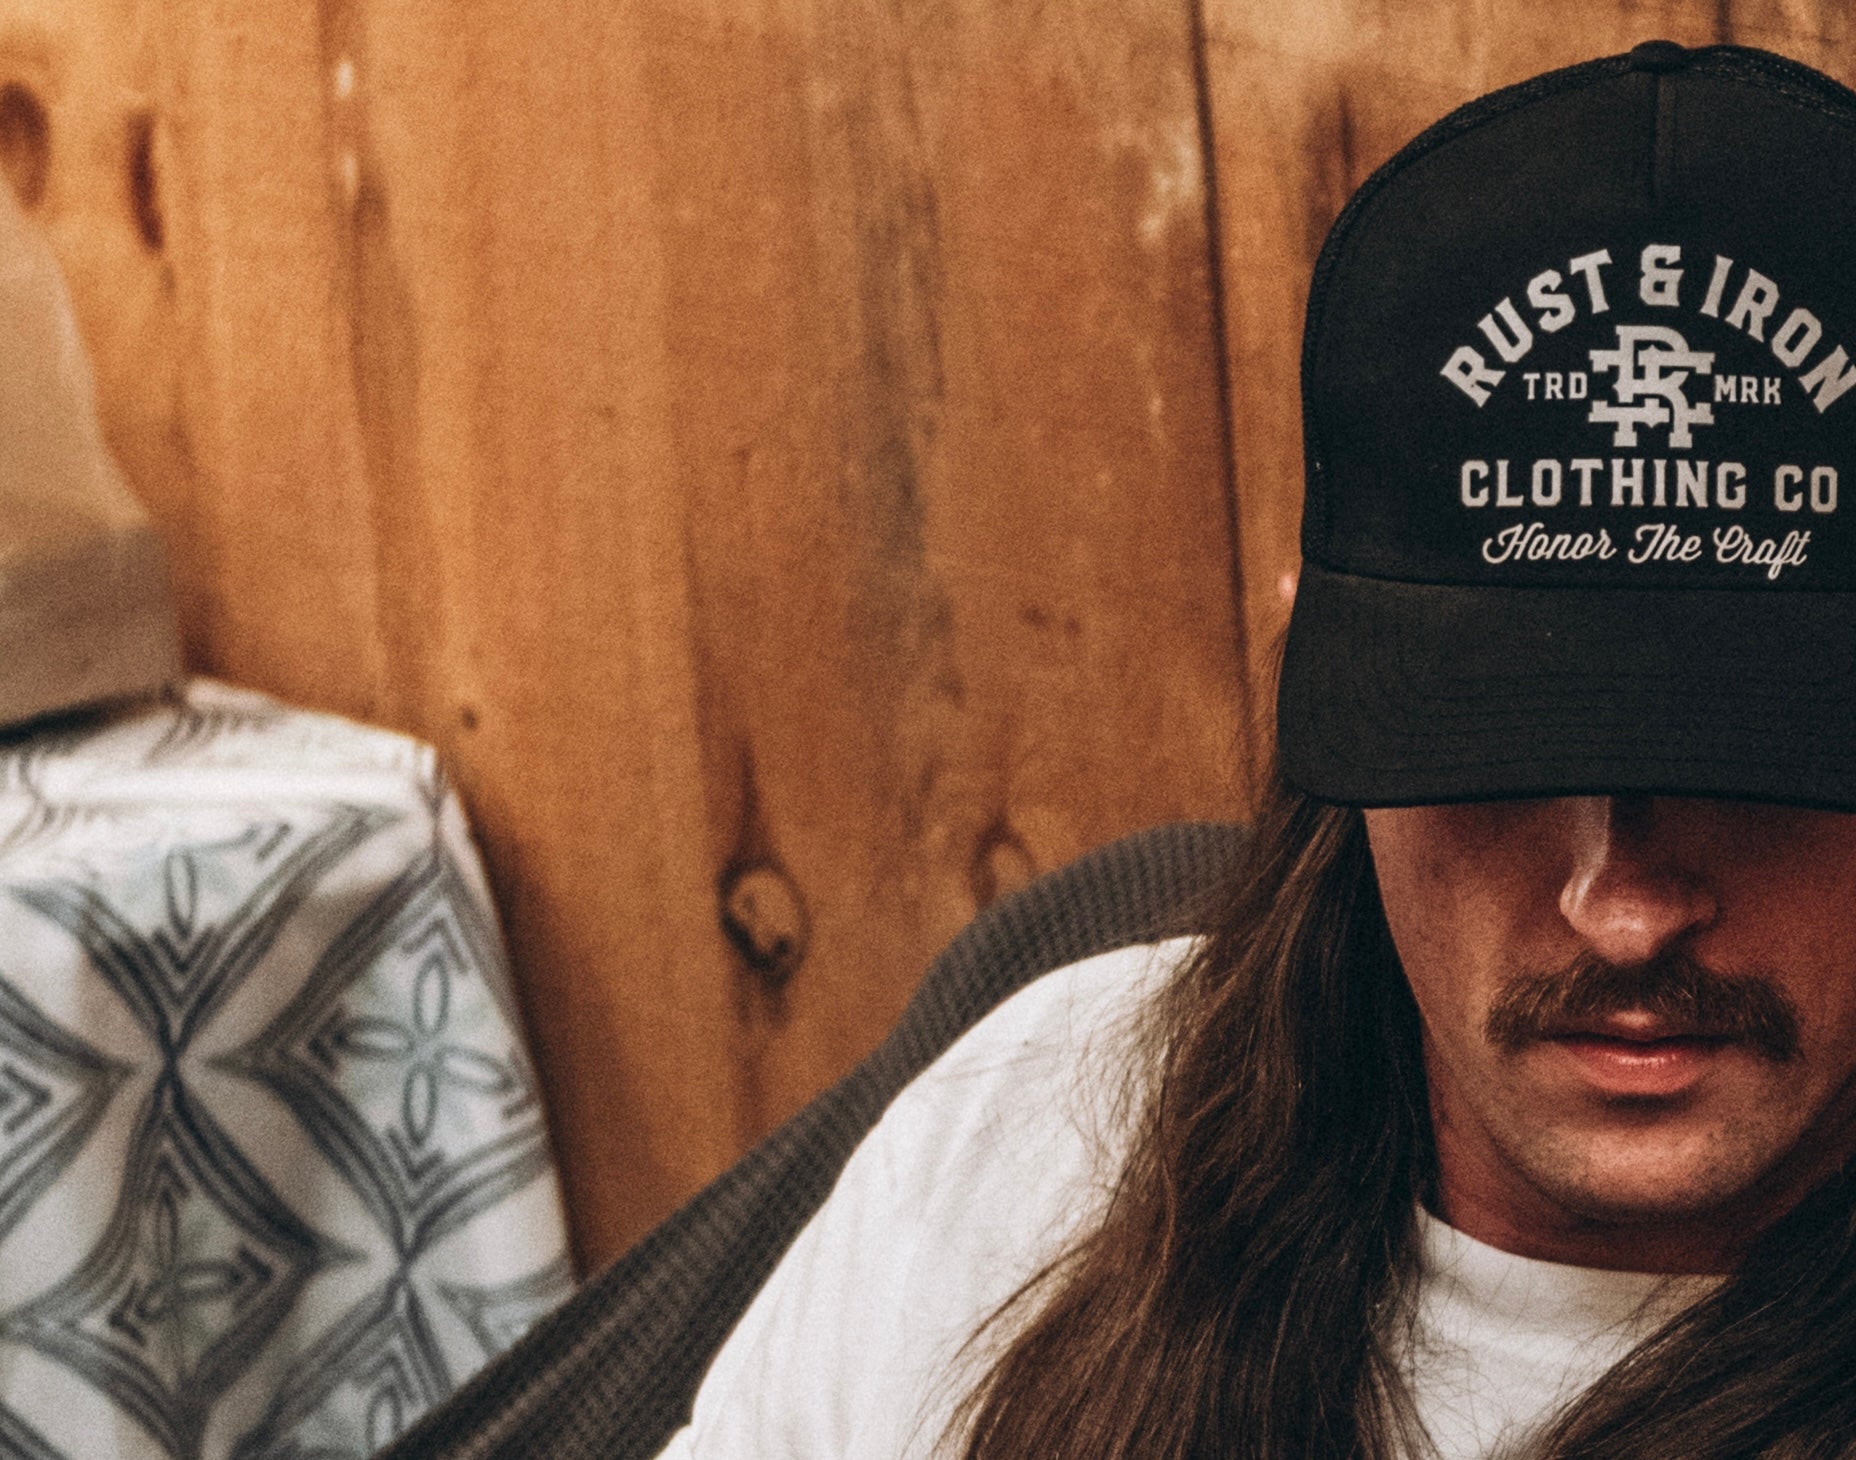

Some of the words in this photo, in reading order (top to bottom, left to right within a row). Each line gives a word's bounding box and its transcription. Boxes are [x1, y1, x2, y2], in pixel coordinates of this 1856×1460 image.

[1439, 249, 1613, 408] RUST
[1639, 243, 1685, 307] &
[1522, 371, 1588, 401] TRD
[1713, 374, 1782, 405] MRK
[1460, 457, 1747, 510] CLOTHING
[1774, 464, 1839, 513] CO
[1482, 522, 1617, 565] Honor
[1628, 523, 1702, 564] The
[1713, 525, 1812, 581] Craft
